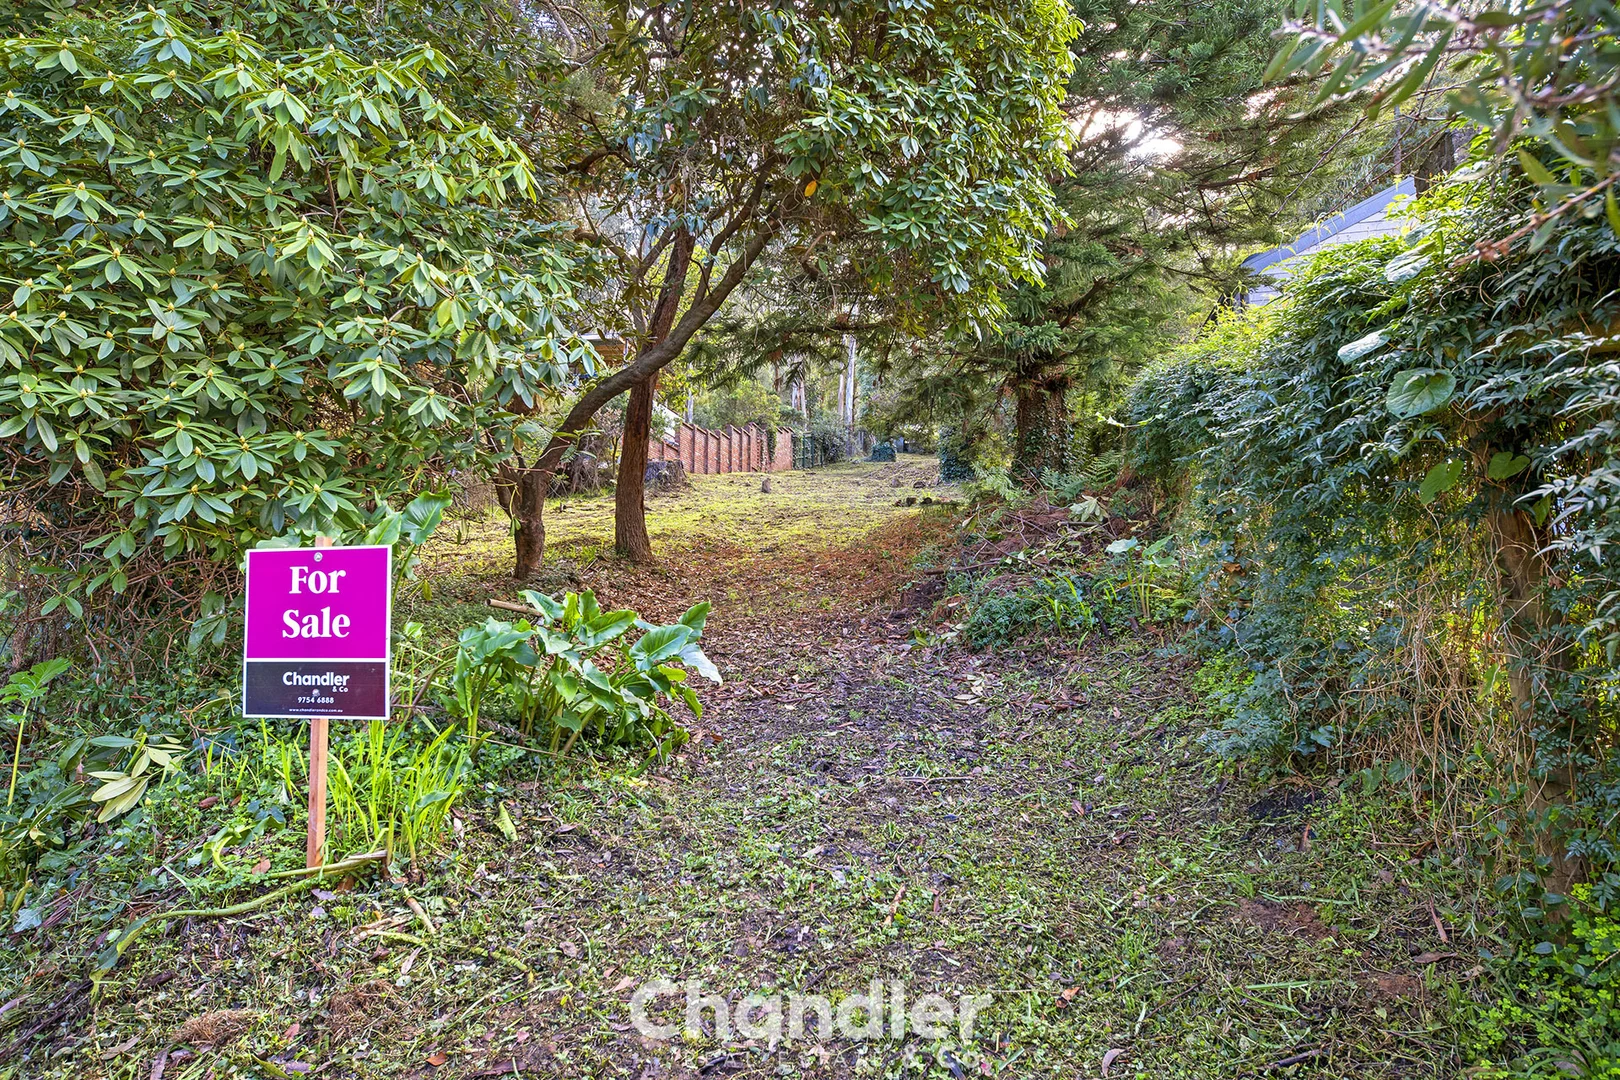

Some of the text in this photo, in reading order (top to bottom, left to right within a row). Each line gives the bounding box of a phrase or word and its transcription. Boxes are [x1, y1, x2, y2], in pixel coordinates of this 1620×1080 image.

[289, 566, 347, 594] For
[282, 606, 351, 638] Sale
[282, 671, 350, 686] Chandler
[332, 685, 349, 693] & Co
[297, 696, 335, 704] 9754 6888
